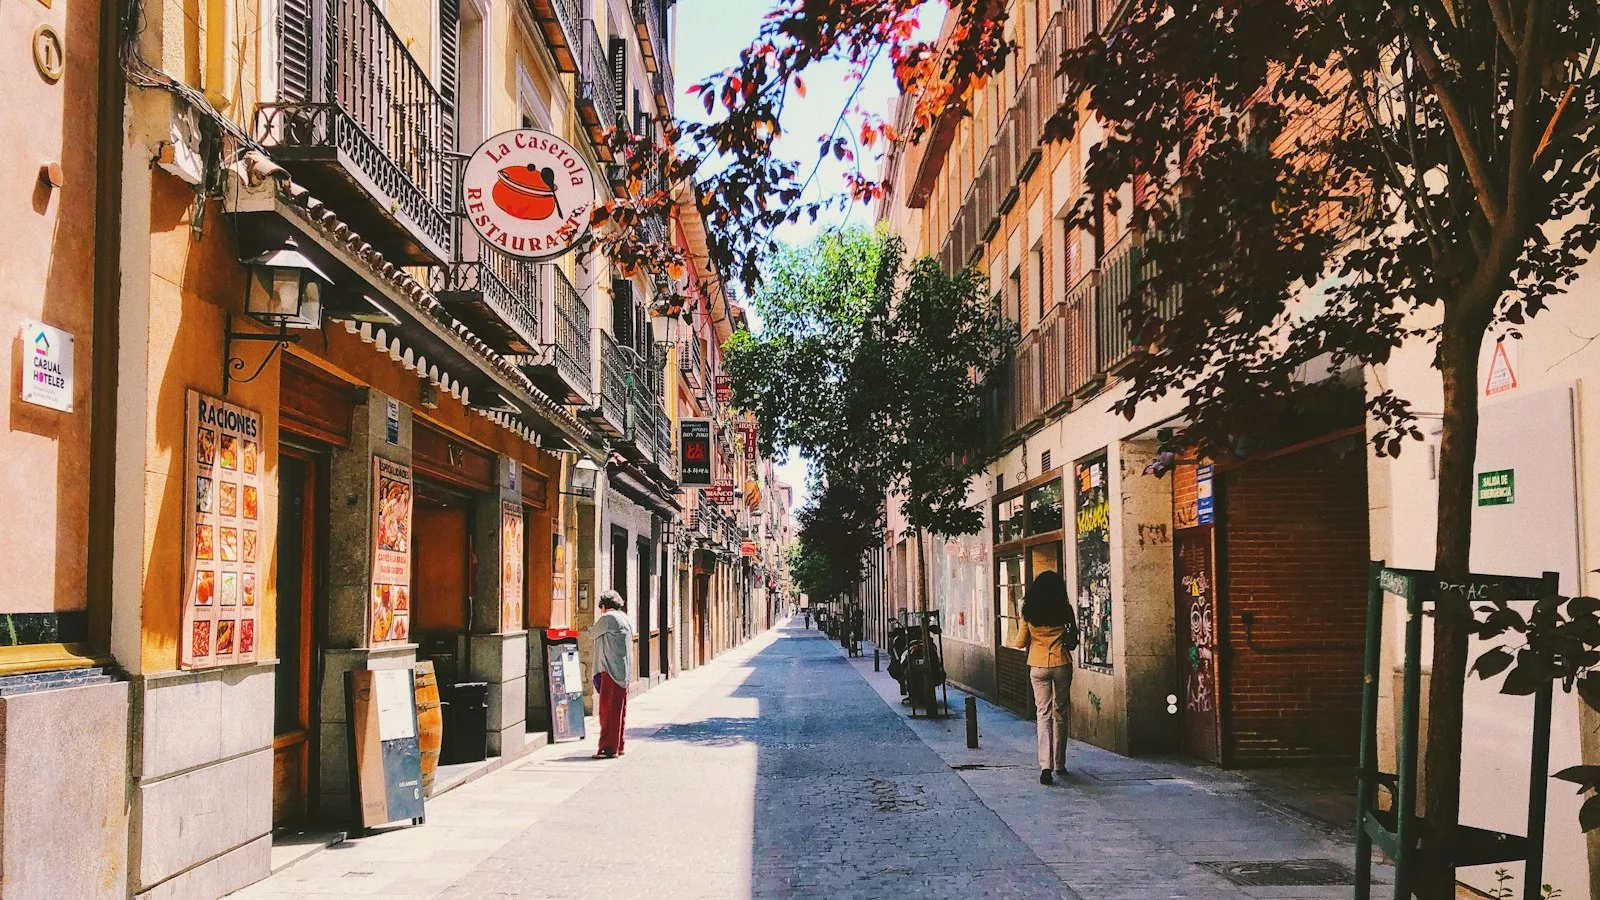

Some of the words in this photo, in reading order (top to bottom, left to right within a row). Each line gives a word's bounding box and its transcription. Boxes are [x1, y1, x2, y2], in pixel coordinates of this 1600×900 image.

[485, 143, 511, 164] La
[514, 133, 584, 186] Caserola
[33, 356, 62, 375] CASUAL
[33, 370, 65, 389] HOTELES
[199, 399, 257, 438] RACIONES
[1482, 475, 1500, 487] SALIDA
[1501, 474, 1508, 485] DE
[1480, 487, 1511, 499] EMERGENCIA
